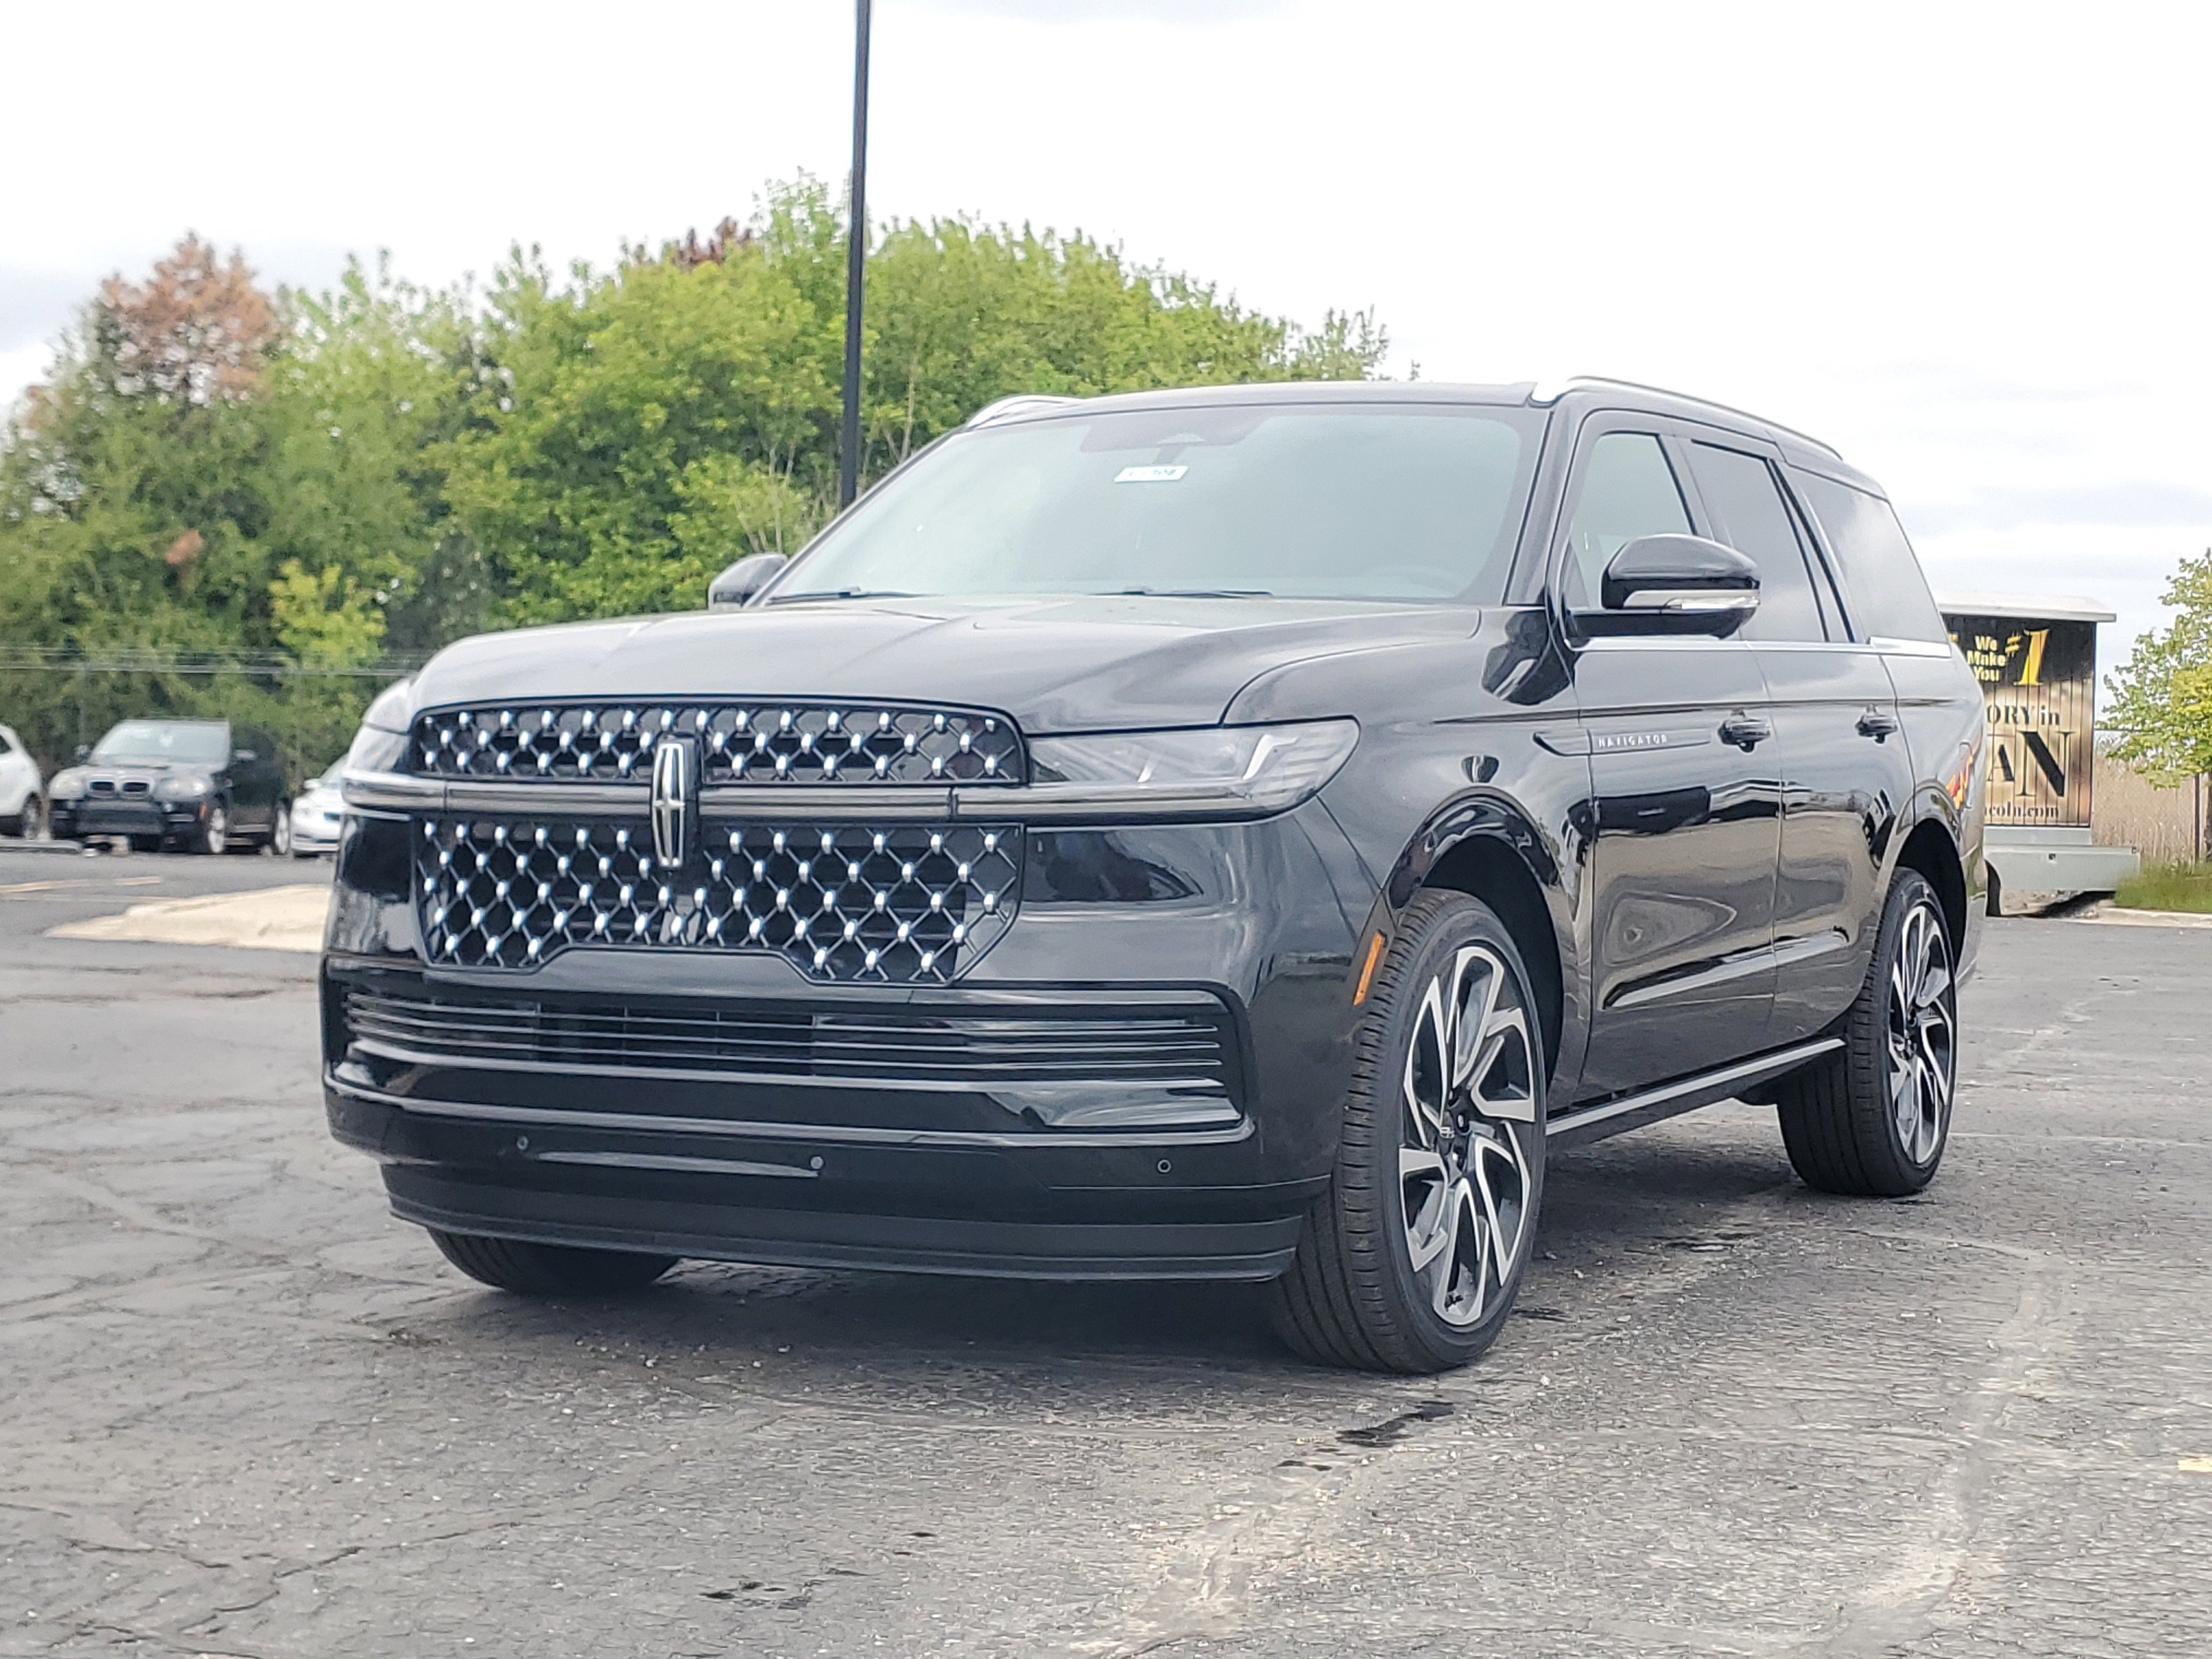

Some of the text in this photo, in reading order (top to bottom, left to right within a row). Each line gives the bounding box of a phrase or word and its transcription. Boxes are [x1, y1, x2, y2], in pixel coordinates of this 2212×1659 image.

[1975, 635, 1997, 651] We
[1967, 650, 2006, 667] Make
[1973, 666, 2000, 681] You
[2041, 705, 2061, 725] in
[1987, 730, 2076, 797] AN
